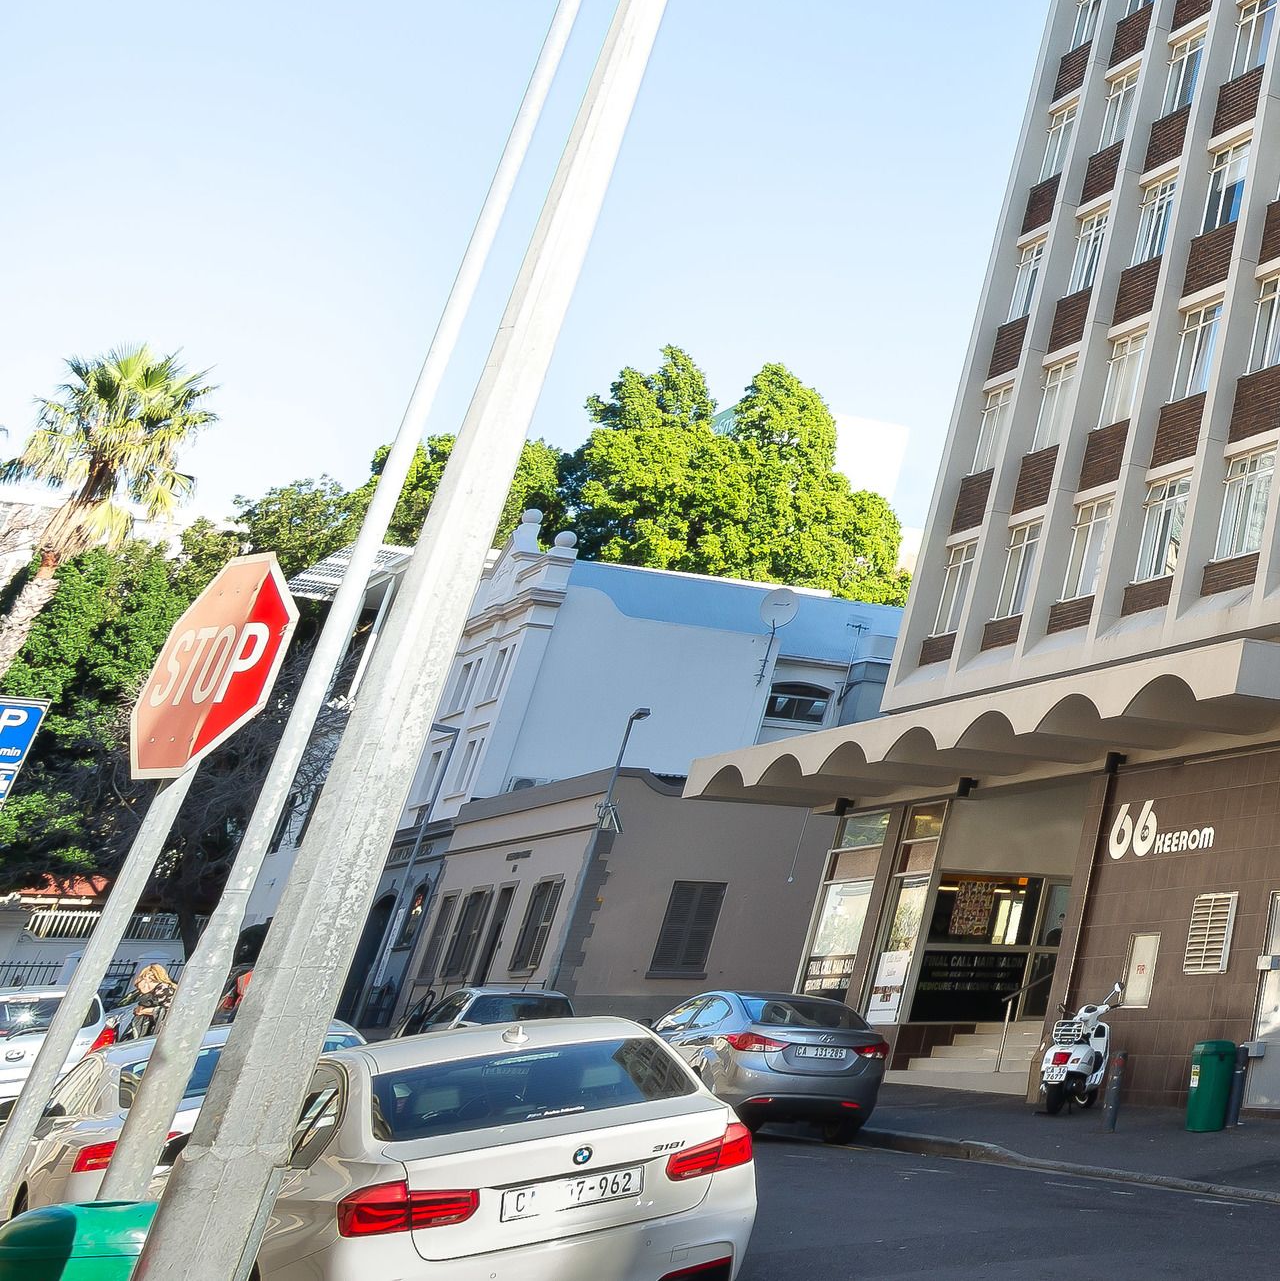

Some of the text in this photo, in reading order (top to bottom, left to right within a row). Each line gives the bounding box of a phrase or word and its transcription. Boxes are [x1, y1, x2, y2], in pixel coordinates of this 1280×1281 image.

[150, 622, 270, 707] STOP
[0, 708, 28, 734] P
[1109, 800, 1215, 859] 66 KEEROM
[950, 955, 972, 967] CALL
[973, 956, 994, 967] HAIR
[797, 1046, 844, 1058] CA 131-285
